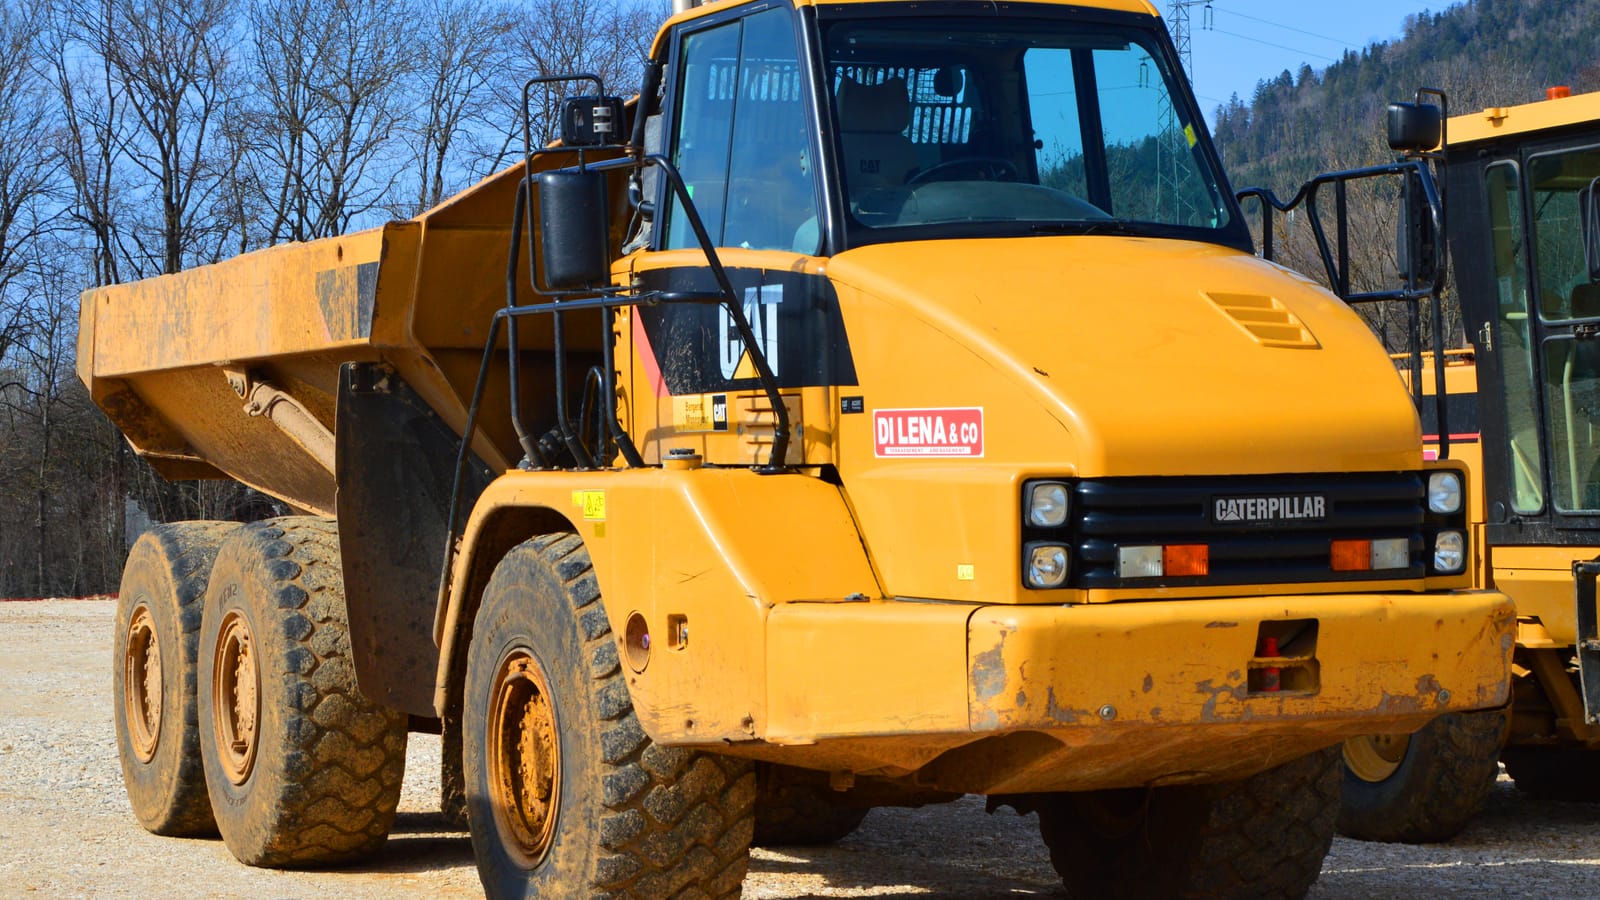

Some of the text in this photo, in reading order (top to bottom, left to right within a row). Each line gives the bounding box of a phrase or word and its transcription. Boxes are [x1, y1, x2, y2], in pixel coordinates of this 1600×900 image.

[860, 159, 881, 174] CAT
[877, 416, 978, 445] DI LENA & CO
[1215, 496, 1325, 521] CATERPILLAR
